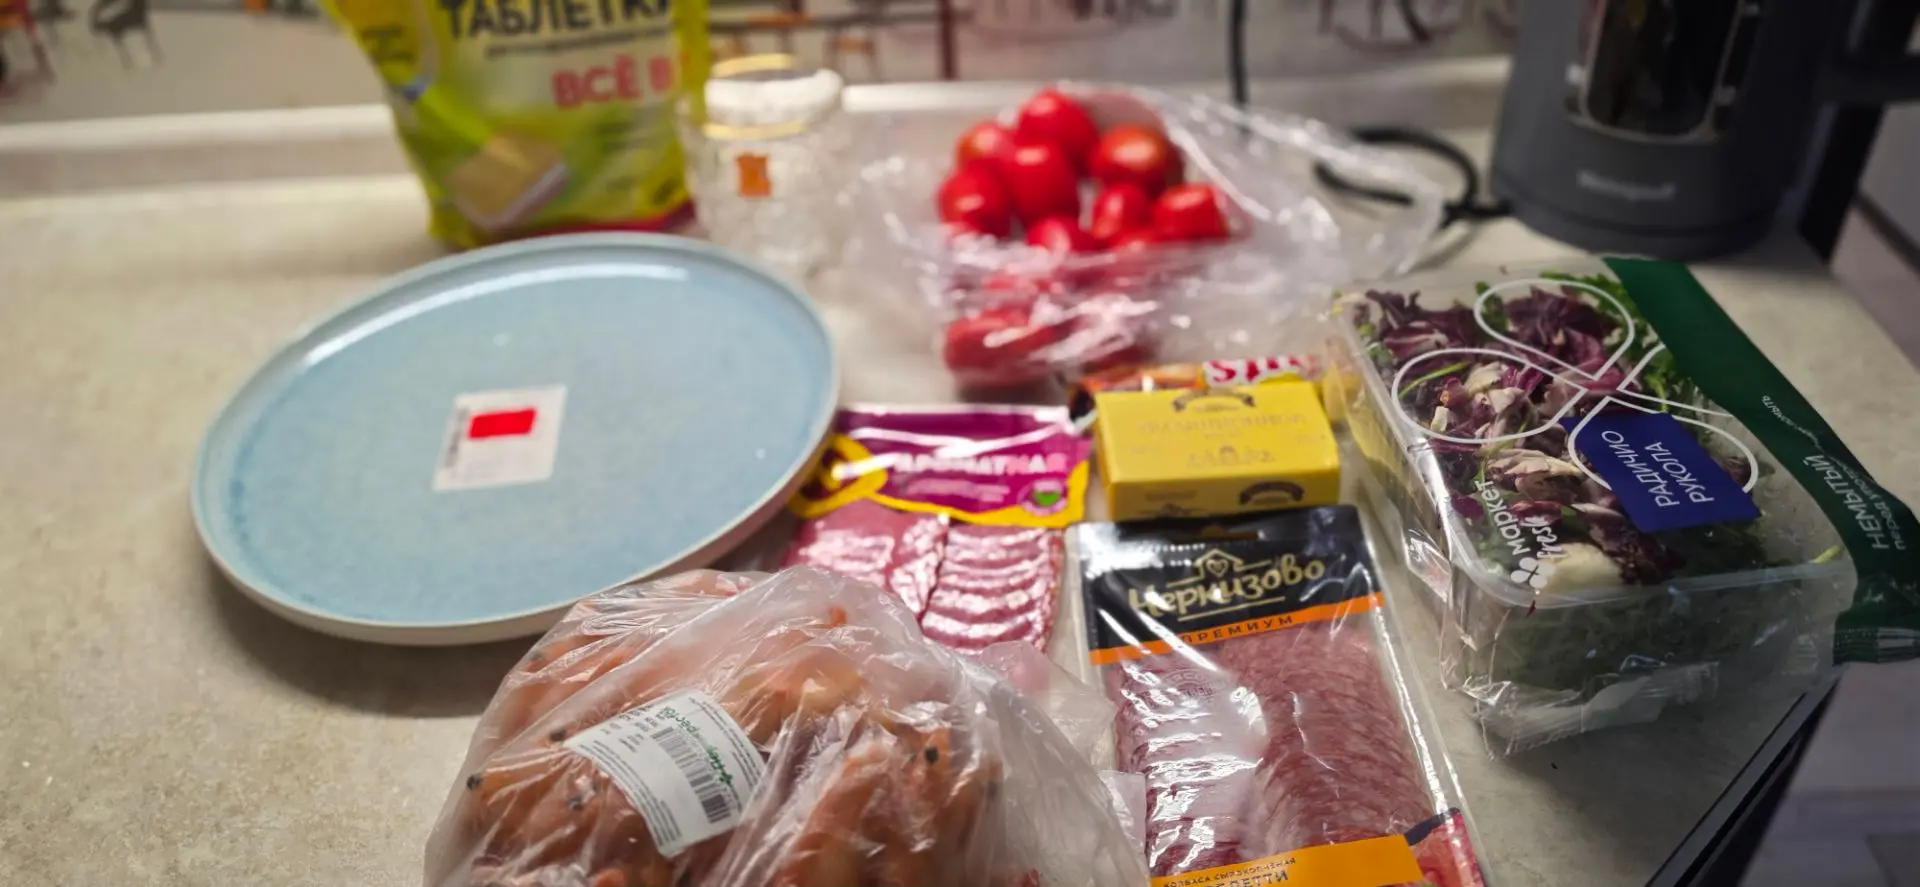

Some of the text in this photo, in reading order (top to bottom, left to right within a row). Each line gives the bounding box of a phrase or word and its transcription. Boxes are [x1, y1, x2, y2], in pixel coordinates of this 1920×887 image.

[1602, 430, 1680, 507] РАДИЧИО
[1645, 442, 1715, 503] РУКОЛА
[1803, 455, 1889, 549] НЕМЫТЫЙ
[1874, 501, 1906, 550] перед
[1128, 553, 1325, 617] Черкизово
[1182, 615, 1293, 643] ПРЕМИУМ
